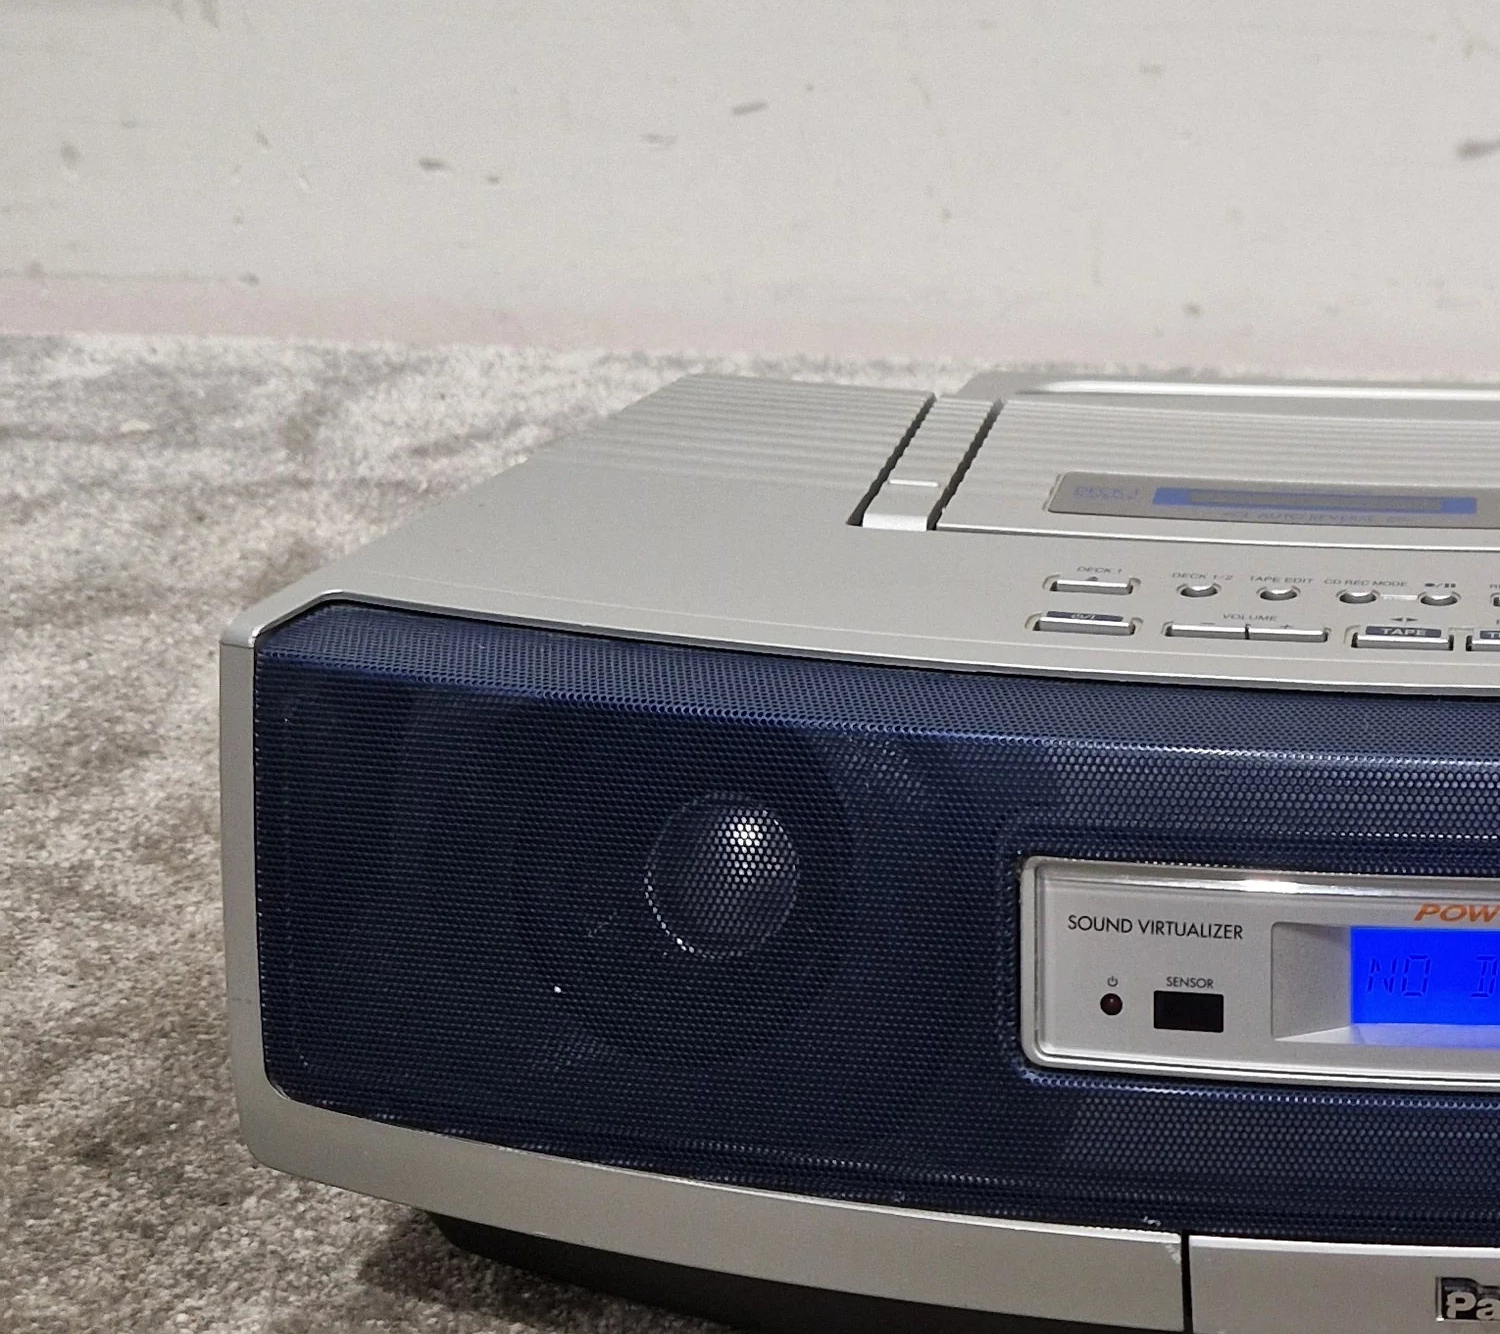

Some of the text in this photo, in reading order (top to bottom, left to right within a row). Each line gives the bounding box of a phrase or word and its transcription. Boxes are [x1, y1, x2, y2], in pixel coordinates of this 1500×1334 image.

[1213, 573, 1233, 581] 1/2
[1250, 575, 1313, 584] TAPE EDIT
[1223, 613, 1276, 621] VOLUME
[1380, 627, 1427, 636] TAPE
[1067, 914, 1244, 940] SOUND VIRTUALIZER
[1367, 953, 1431, 997] NO
[1165, 976, 1214, 989] SENSOR
